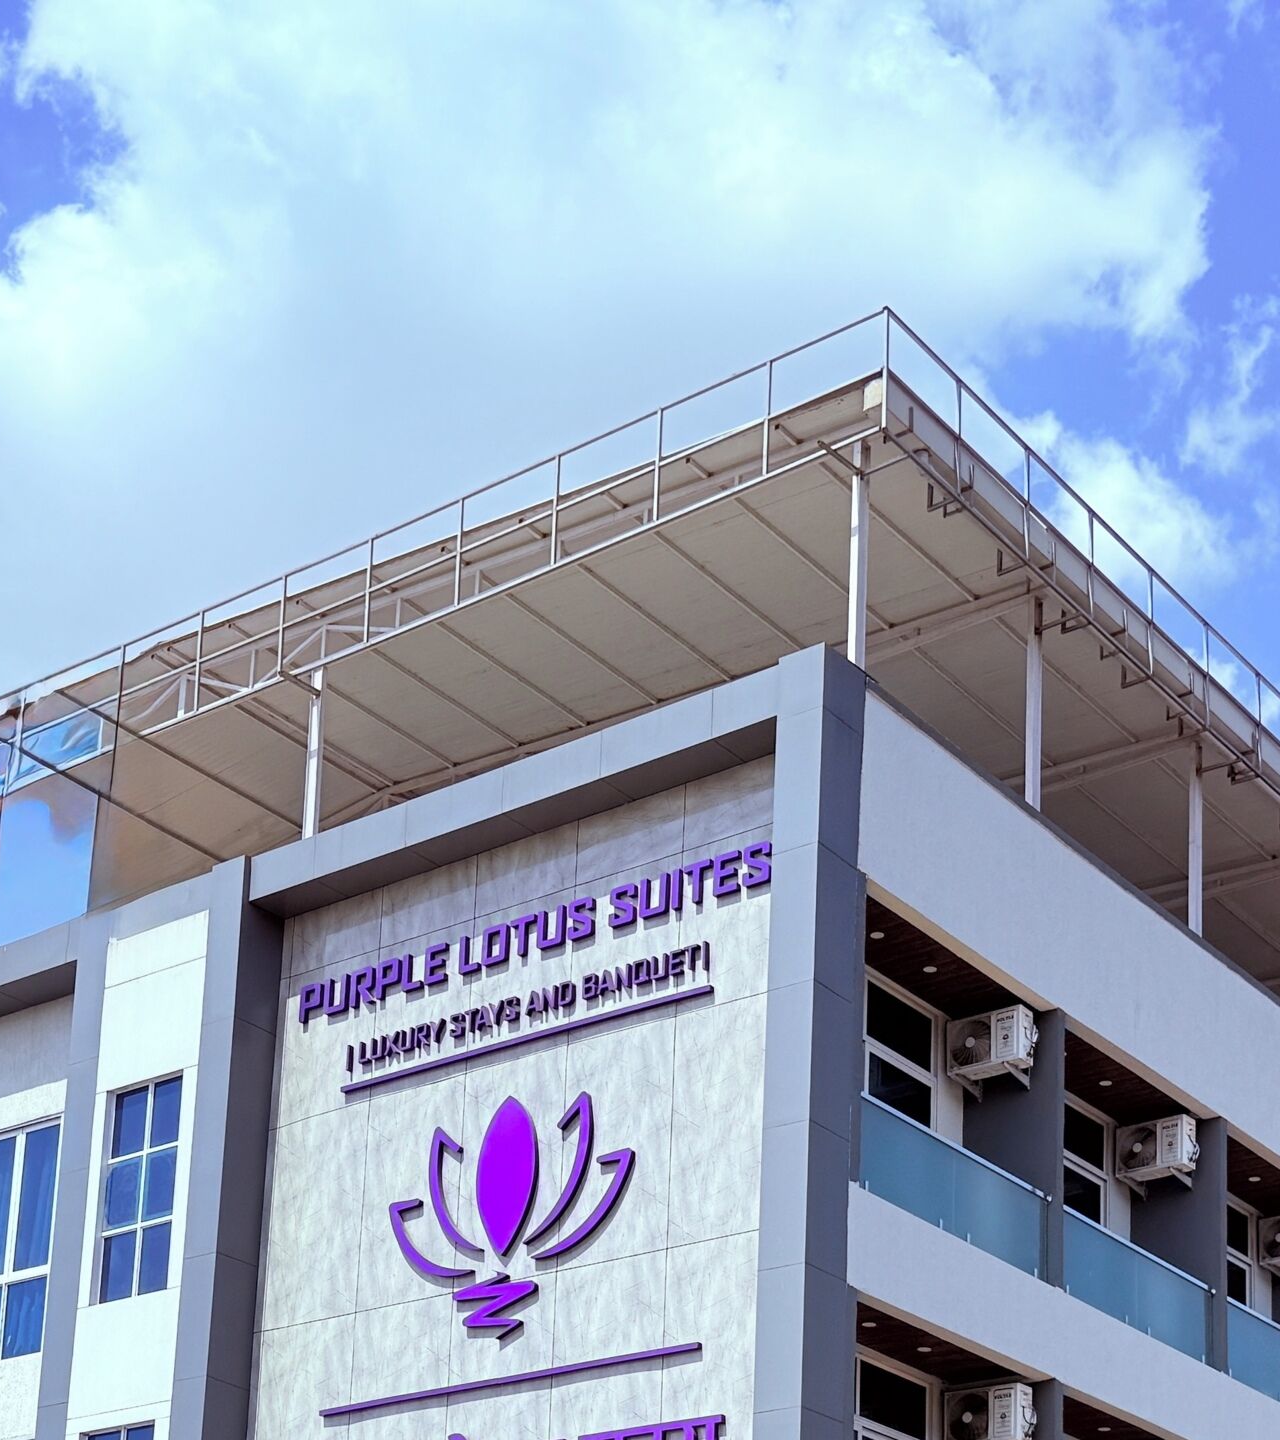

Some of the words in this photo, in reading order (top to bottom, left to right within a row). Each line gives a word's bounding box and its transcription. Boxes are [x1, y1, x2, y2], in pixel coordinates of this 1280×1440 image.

[297, 942, 448, 1024] PURPLE
[457, 896, 596, 974] LOTUS
[608, 840, 772, 929] SUITES
[358, 1017, 447, 1064] LUXURY
[449, 995, 521, 1038] STAYS
[524, 980, 577, 1017] AND
